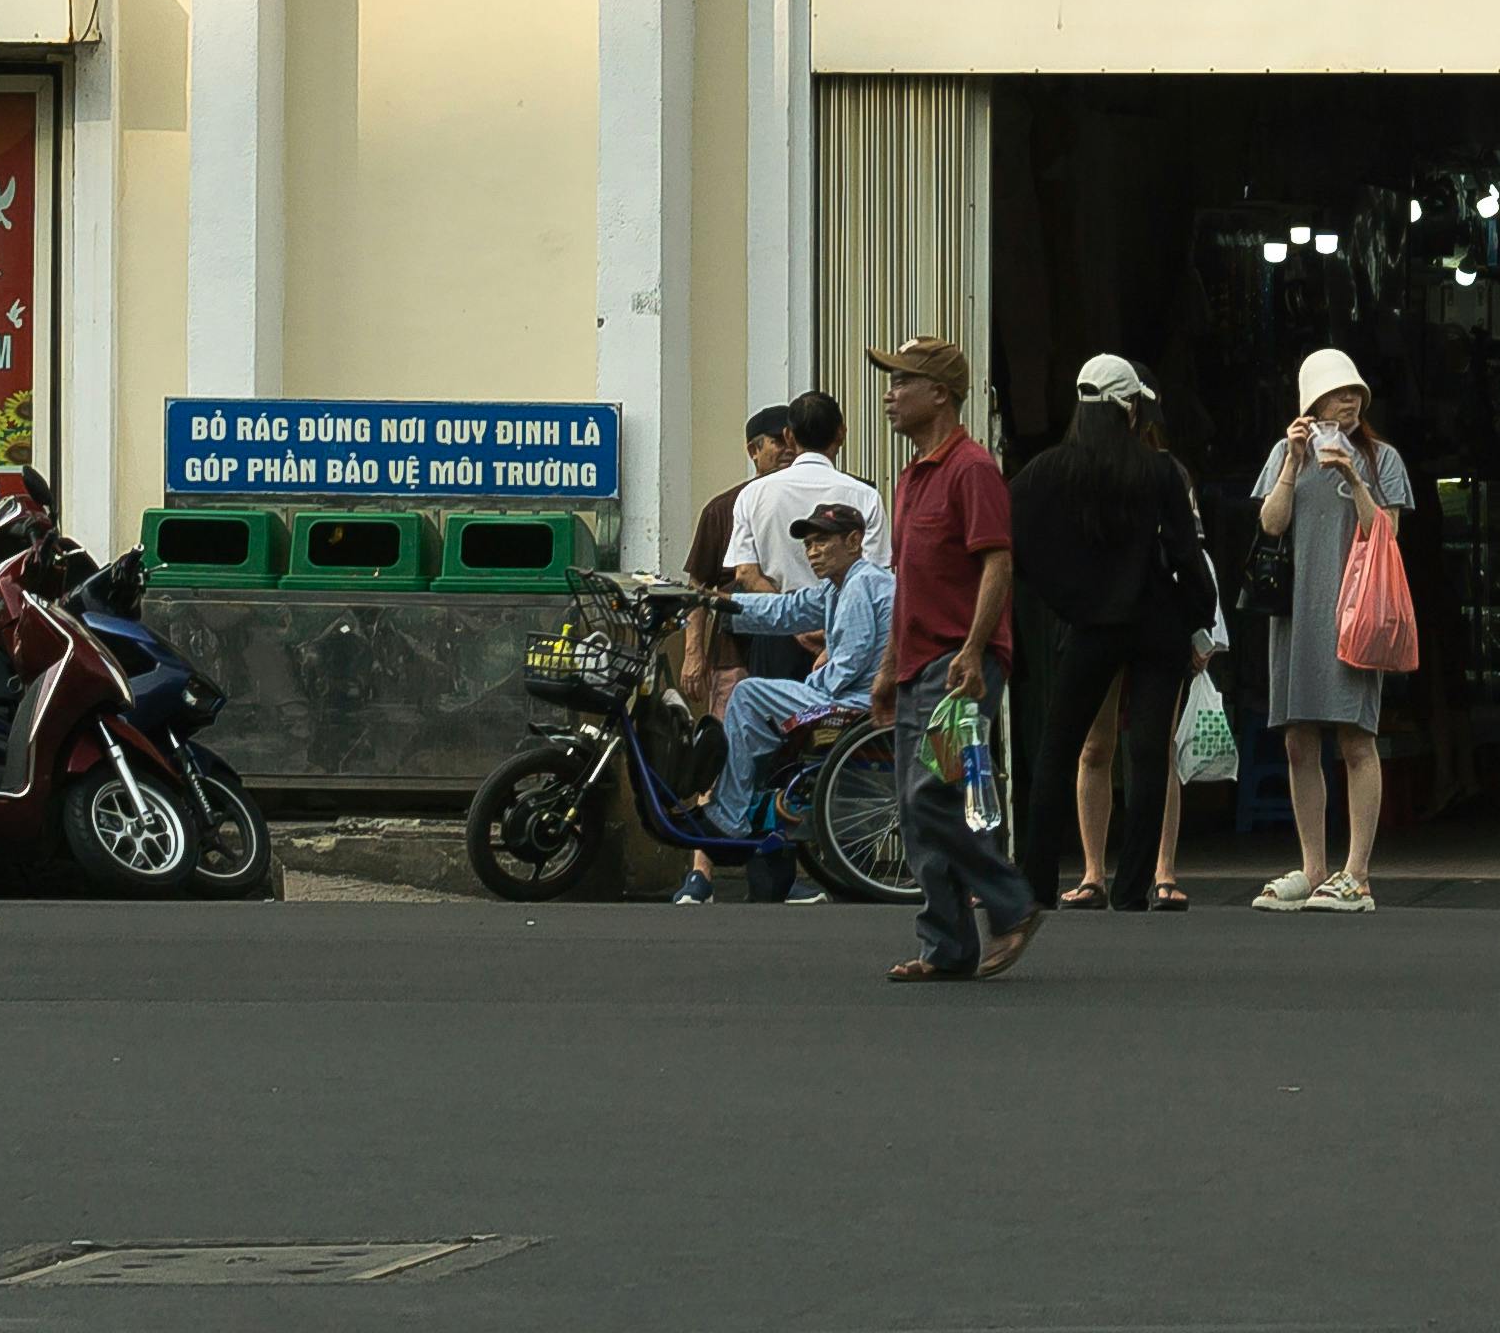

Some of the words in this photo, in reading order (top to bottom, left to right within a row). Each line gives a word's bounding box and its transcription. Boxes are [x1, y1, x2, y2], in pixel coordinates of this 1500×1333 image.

[191, 409, 227, 440] BỎ
[236, 412, 289, 441] RÁC
[298, 413, 371, 443] ĐÚNG
[381, 417, 426, 443] NƠI
[435, 419, 488, 445] QUY
[495, 420, 560, 451] ĐỊNH
[570, 416, 600, 446] LÀ
[185, 452, 238, 482] GÓP
[247, 448, 317, 483] PHẦN
[326, 452, 379, 483] BẢO
[388, 455, 420, 489] VỆ
[429, 456, 483, 485] MÔI
[492, 456, 598, 487] TRƯỜNG
